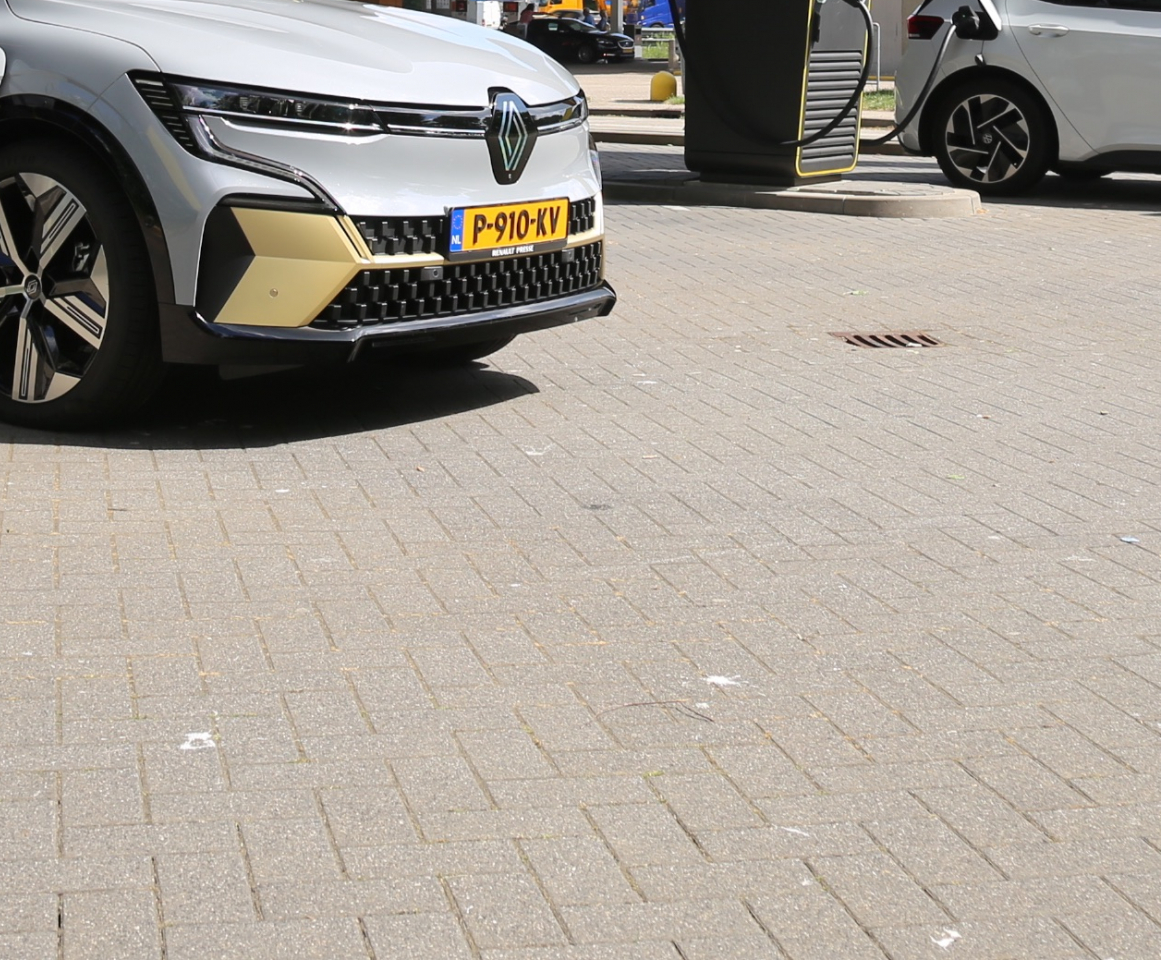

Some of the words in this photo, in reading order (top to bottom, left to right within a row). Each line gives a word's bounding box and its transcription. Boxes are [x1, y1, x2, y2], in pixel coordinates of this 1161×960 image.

[473, 206, 561, 245] P-910-KV
[451, 235, 461, 245] NL
[492, 247, 515, 257] RENAULT
